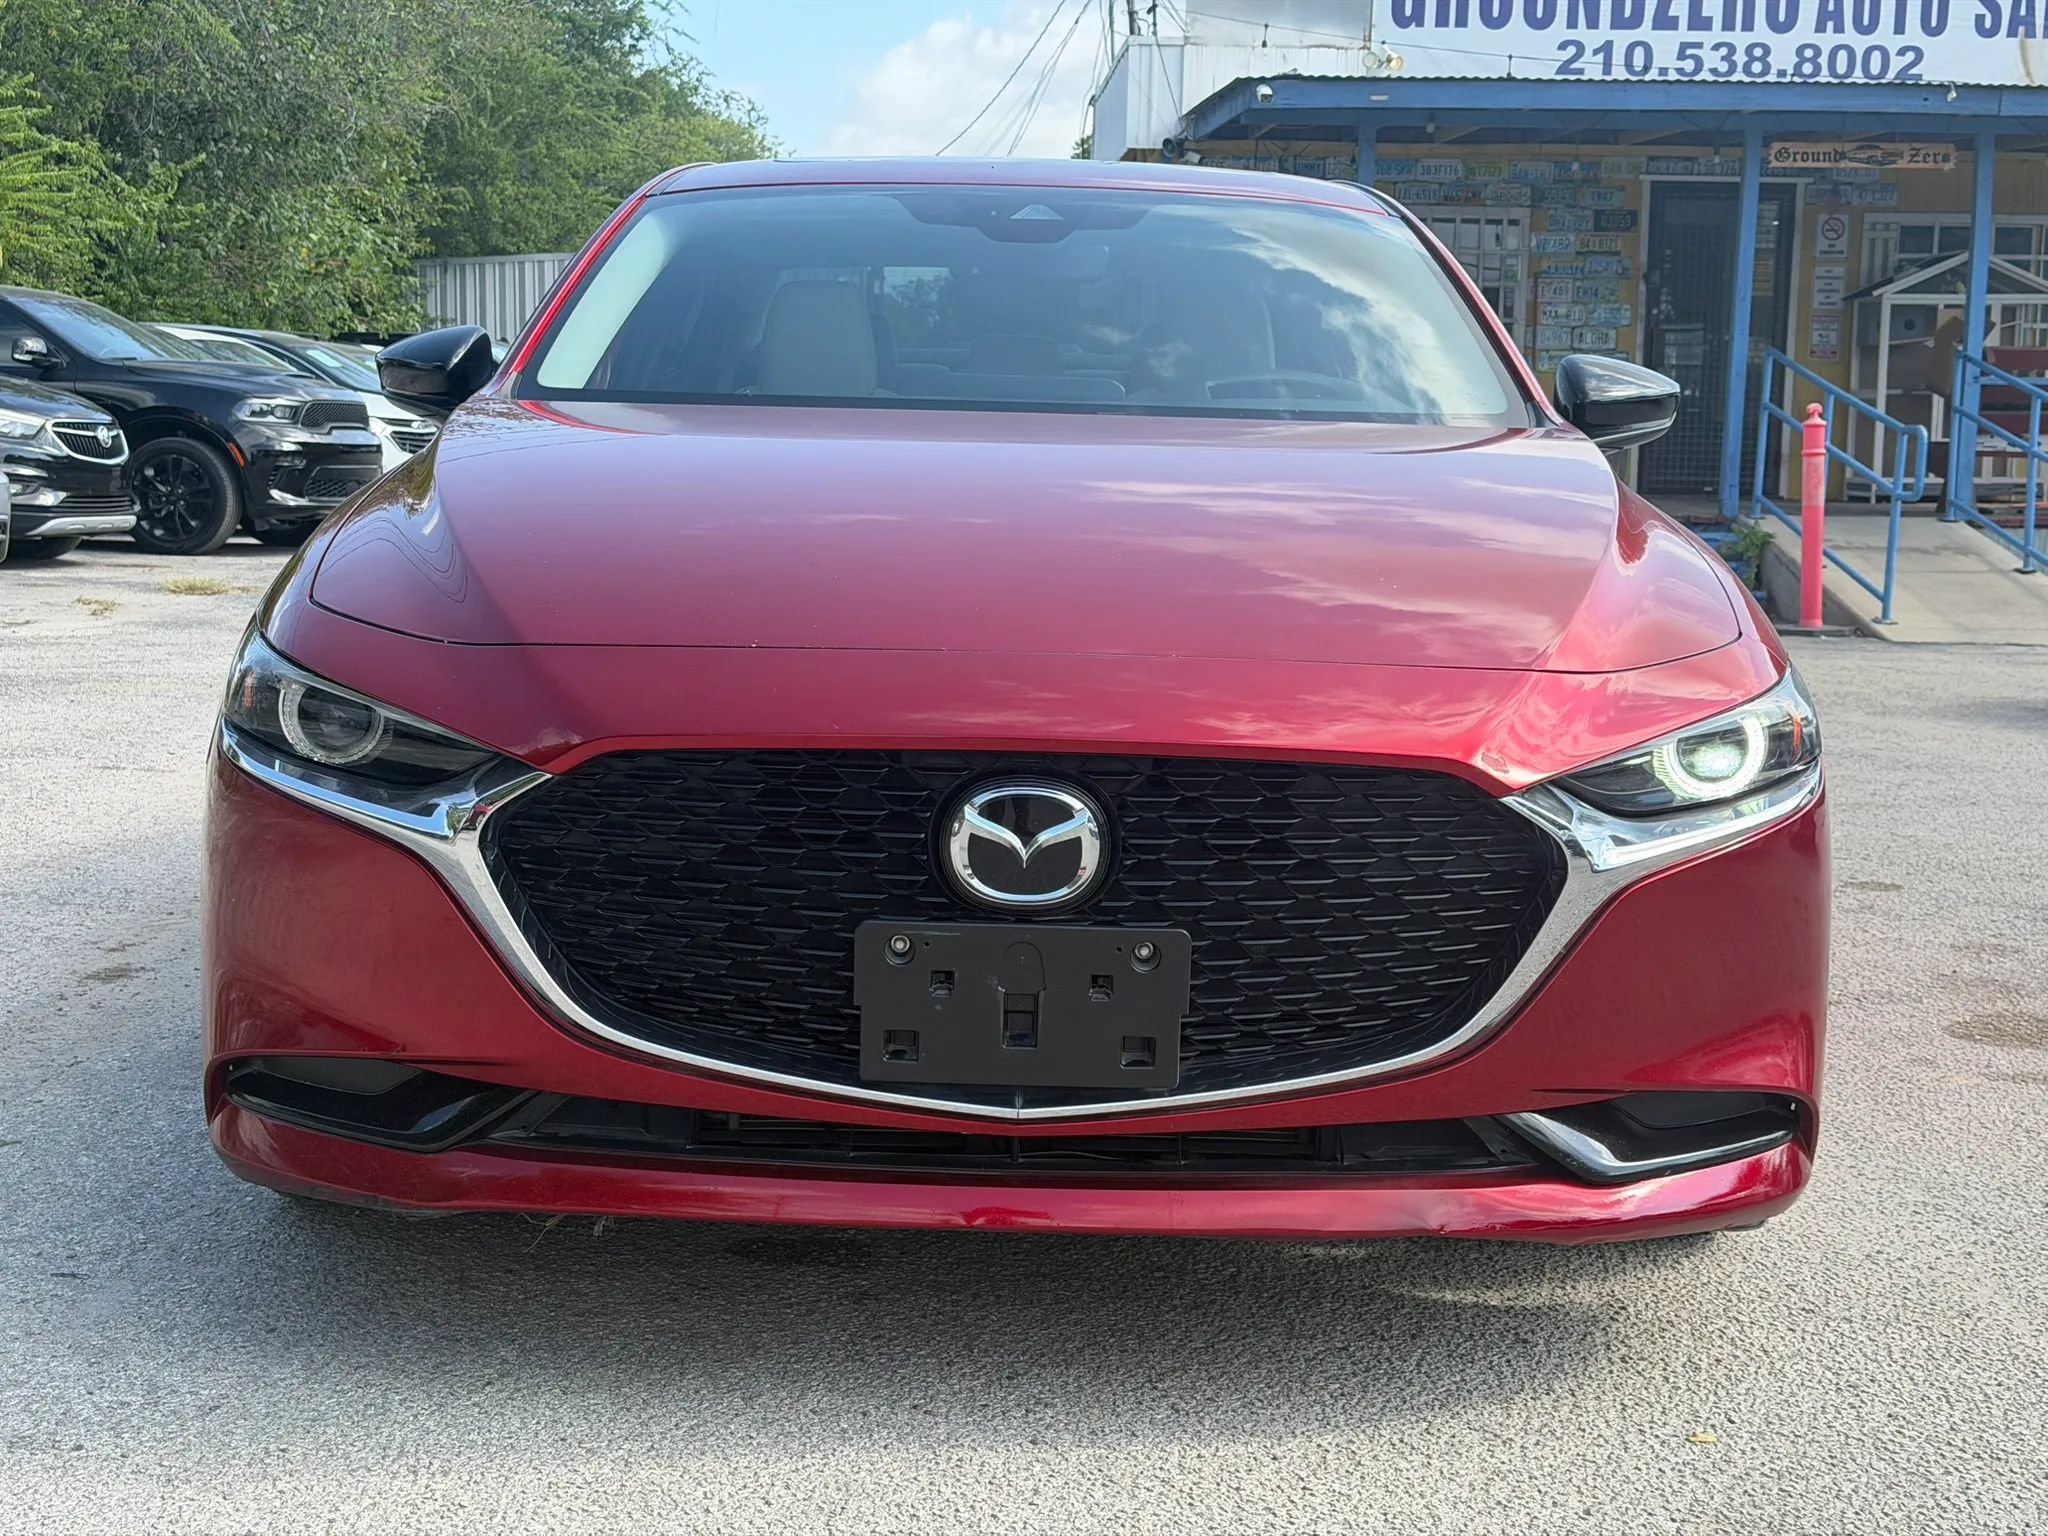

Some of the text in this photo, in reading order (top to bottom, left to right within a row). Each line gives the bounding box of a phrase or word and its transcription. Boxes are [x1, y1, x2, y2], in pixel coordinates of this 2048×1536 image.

[1555, 39, 1925, 80] 210.538.8002
[1774, 146, 1952, 165] Ground Zero
